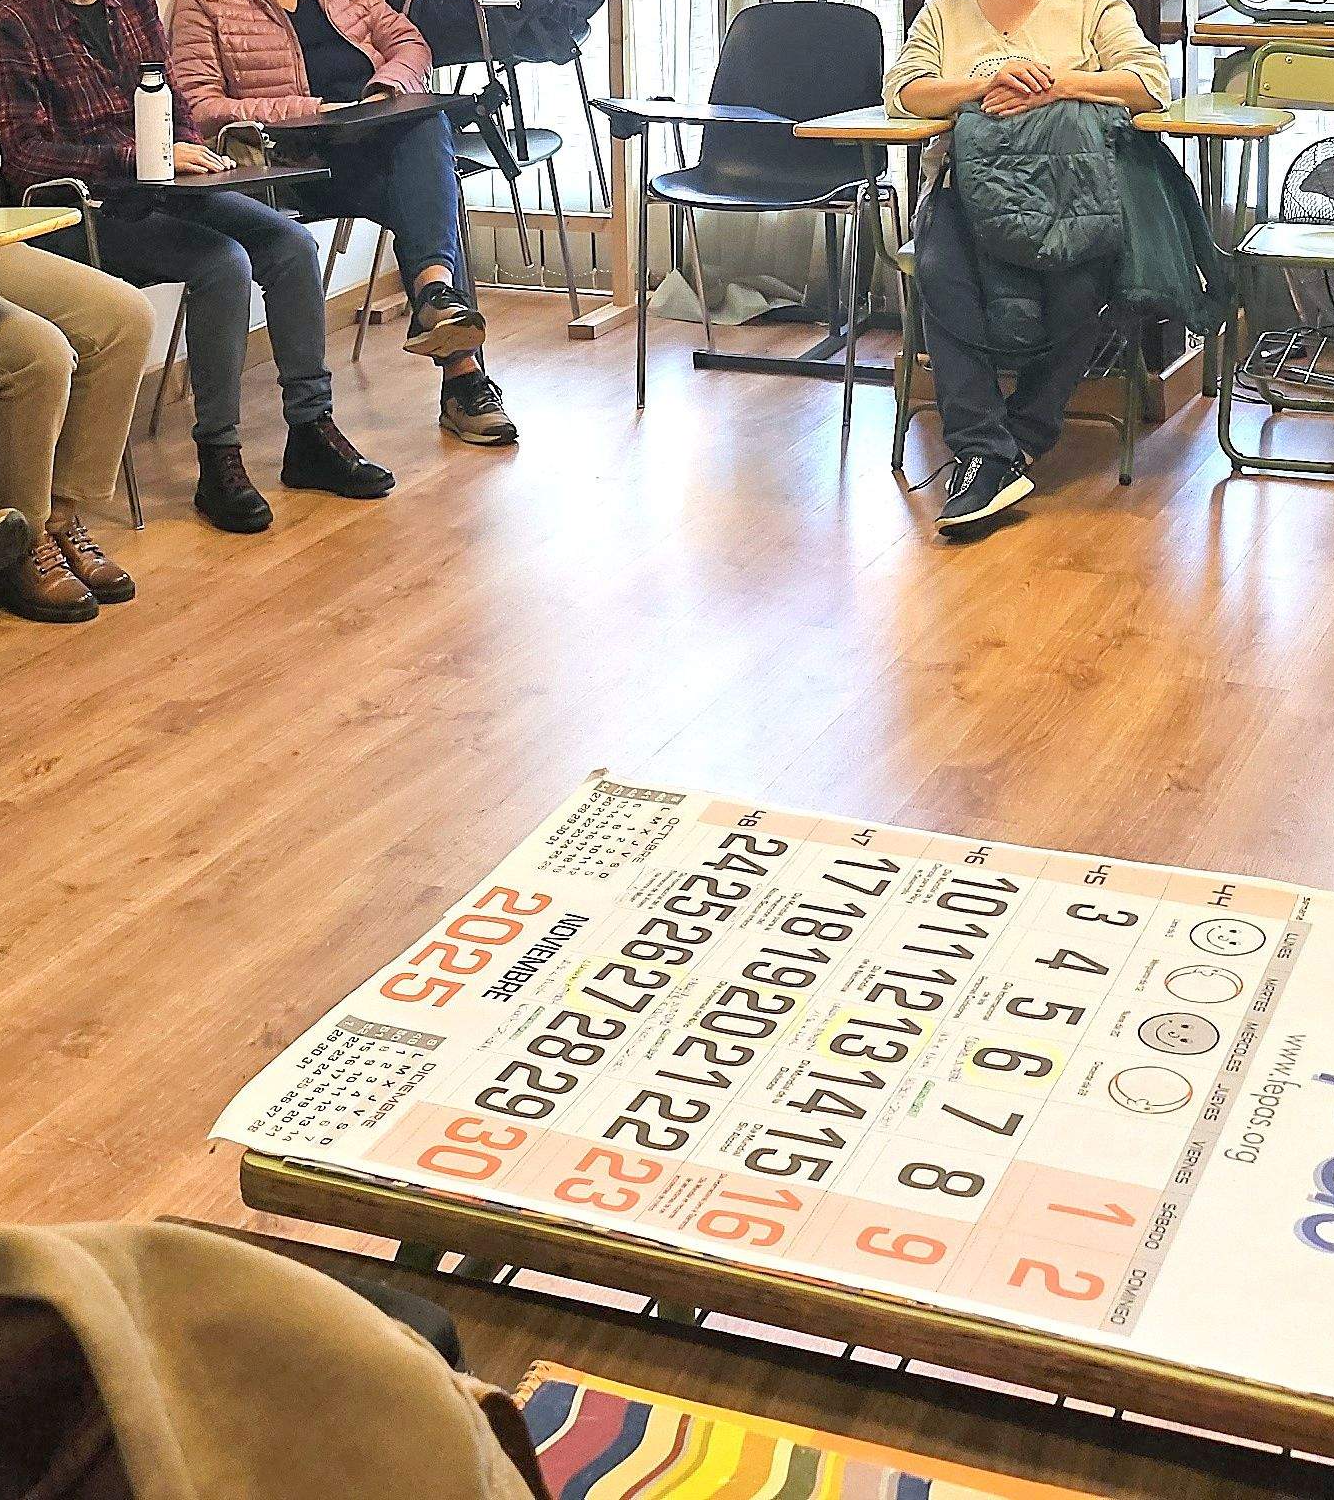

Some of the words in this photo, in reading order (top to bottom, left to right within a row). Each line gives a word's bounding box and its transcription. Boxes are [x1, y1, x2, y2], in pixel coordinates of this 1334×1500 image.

[631, 817, 680, 863] OCTUBRE
[737, 810, 767, 827] 48
[851, 829, 877, 846] 47
[702, 832, 788, 877] 24
[964, 847, 992, 865] 46
[1084, 865, 1112, 885] 45
[663, 874, 751, 922] 25
[822, 858, 901, 897] 17
[936, 878, 1020, 917] 10
[1207, 884, 1236, 907] 44
[781, 903, 867, 942] 18
[1066, 904, 1139, 927] 3
[379, 885, 553, 1008] 2025
[481, 913, 589, 1002] NOVIEMBRE
[621, 917, 713, 966] 26
[902, 923, 989, 960] 11
[1034, 948, 1109, 976] 4
[1277, 933, 1299, 959] LUNES
[581, 962, 672, 1014] 27
[742, 947, 831, 988] 19
[864, 969, 957, 1011] 12
[1005, 997, 1086, 1025] 5
[1253, 978, 1278, 1012] MARTES
[699, 985, 796, 1039] 20
[526, 1010, 627, 1066] 28
[829, 1018, 923, 1063] 13
[1226, 1022, 1258, 1072] MIÉRCOLES
[655, 1036, 755, 1089] 21
[972, 1047, 1053, 1078] 6
[361, 1063, 437, 1128] DICIEMBRE
[474, 1060, 579, 1120] 29
[786, 1071, 886, 1120] 14
[1203, 1083, 1230, 1121] JUEVES
[1224, 1035, 1306, 1164] www.fepas.org
[601, 1089, 711, 1151] 22
[941, 1103, 1024, 1137] 7
[417, 1117, 528, 1181] 30
[744, 1127, 847, 1182] 15
[1175, 1141, 1206, 1184] VIERNES
[554, 1147, 663, 1212] 23
[897, 1162, 985, 1198] 8
[696, 1189, 803, 1247] 16
[1047, 1203, 1137, 1227] 1
[1144, 1202, 1177, 1250] SÁBADO
[856, 1226, 947, 1265] 9
[1007, 1258, 1105, 1301] 2
[1110, 1268, 1147, 1325] DOMINGO
